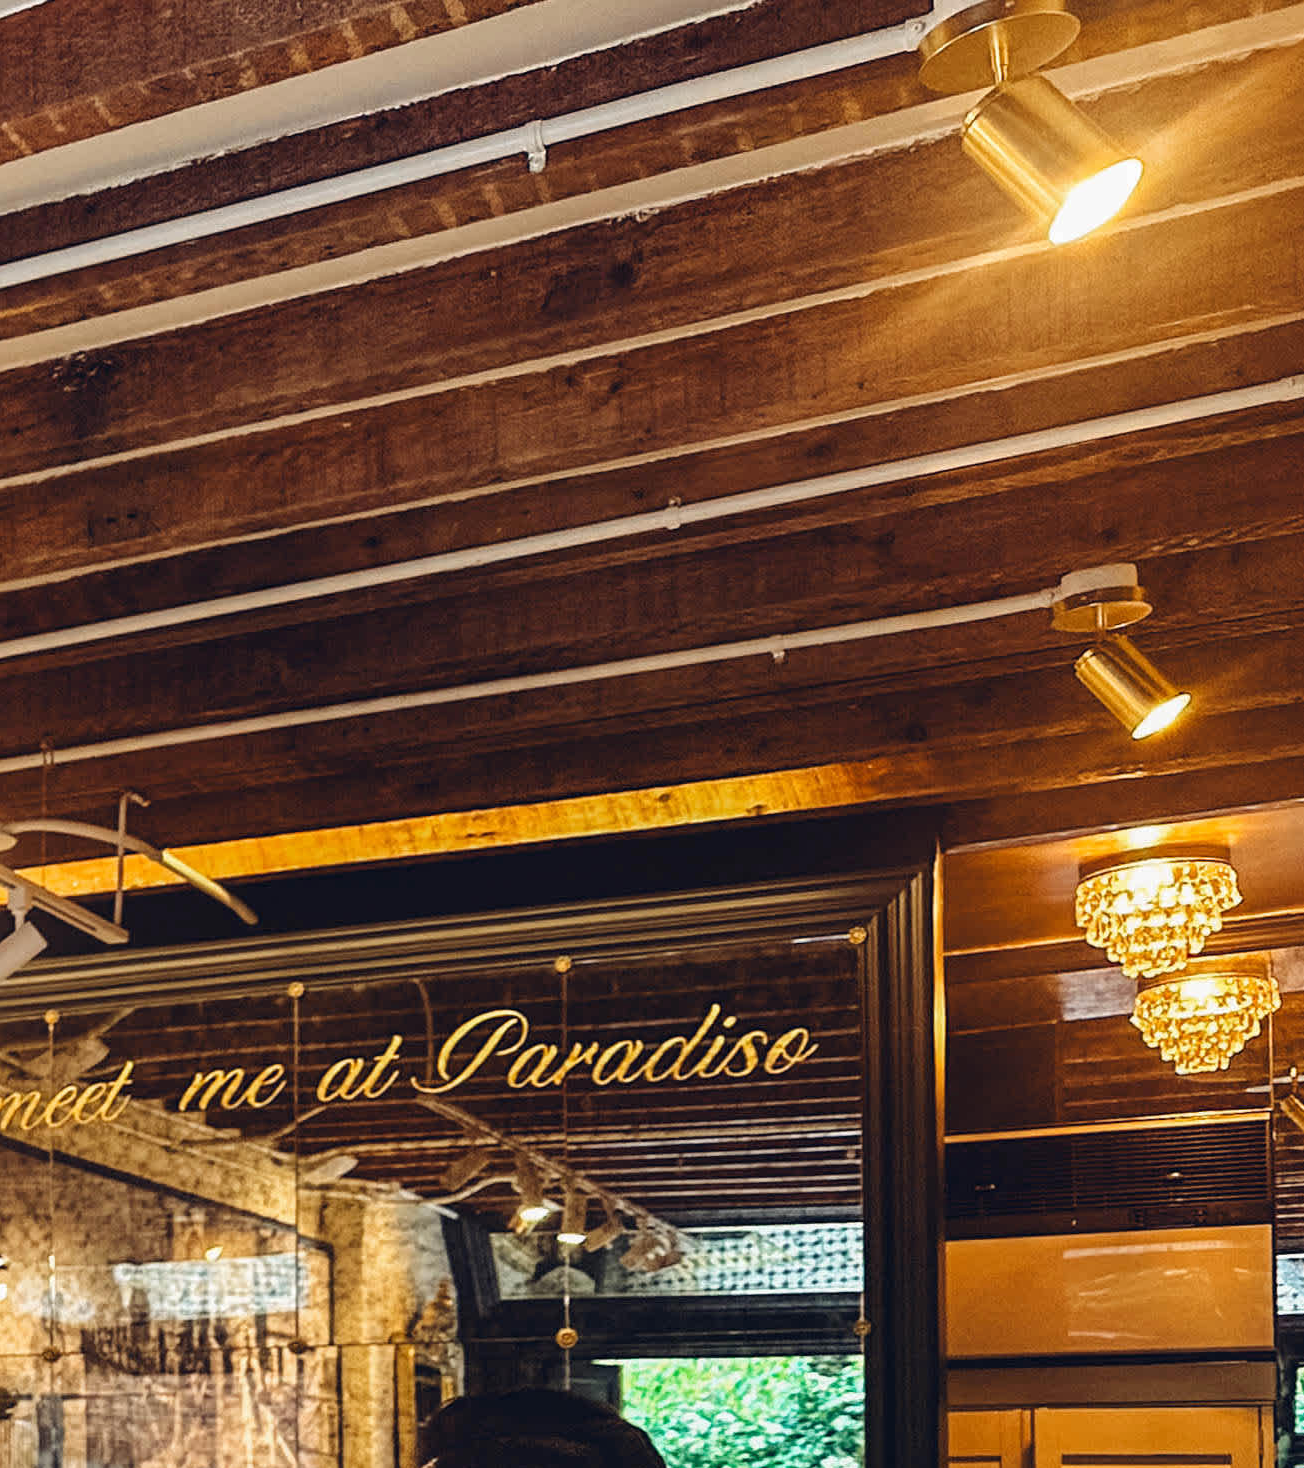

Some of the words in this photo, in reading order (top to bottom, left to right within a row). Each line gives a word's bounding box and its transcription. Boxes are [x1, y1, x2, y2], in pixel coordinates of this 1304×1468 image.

[178, 1063, 288, 1112] me
[316, 1034, 409, 1102] at
[410, 1003, 818, 1093] Paradiso
